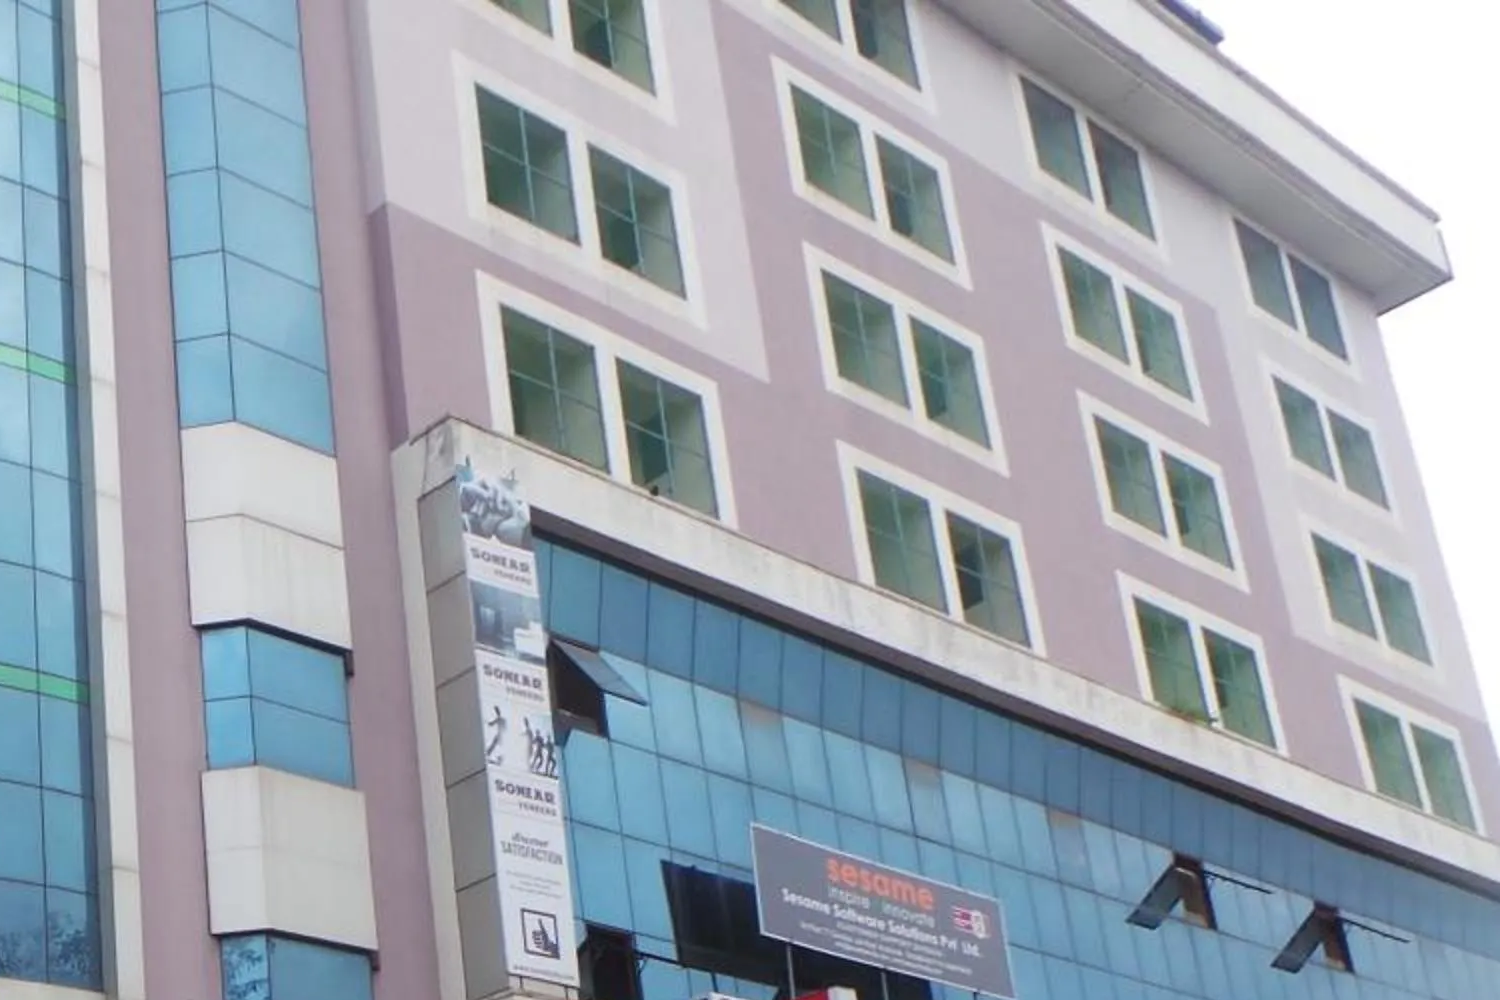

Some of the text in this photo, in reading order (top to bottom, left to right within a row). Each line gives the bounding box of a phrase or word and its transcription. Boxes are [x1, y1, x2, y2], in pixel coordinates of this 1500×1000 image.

[827, 857, 934, 910] sesame
[781, 888, 830, 915] Sesame
[833, 903, 885, 930] Software
[888, 920, 938, 945] Solutions
